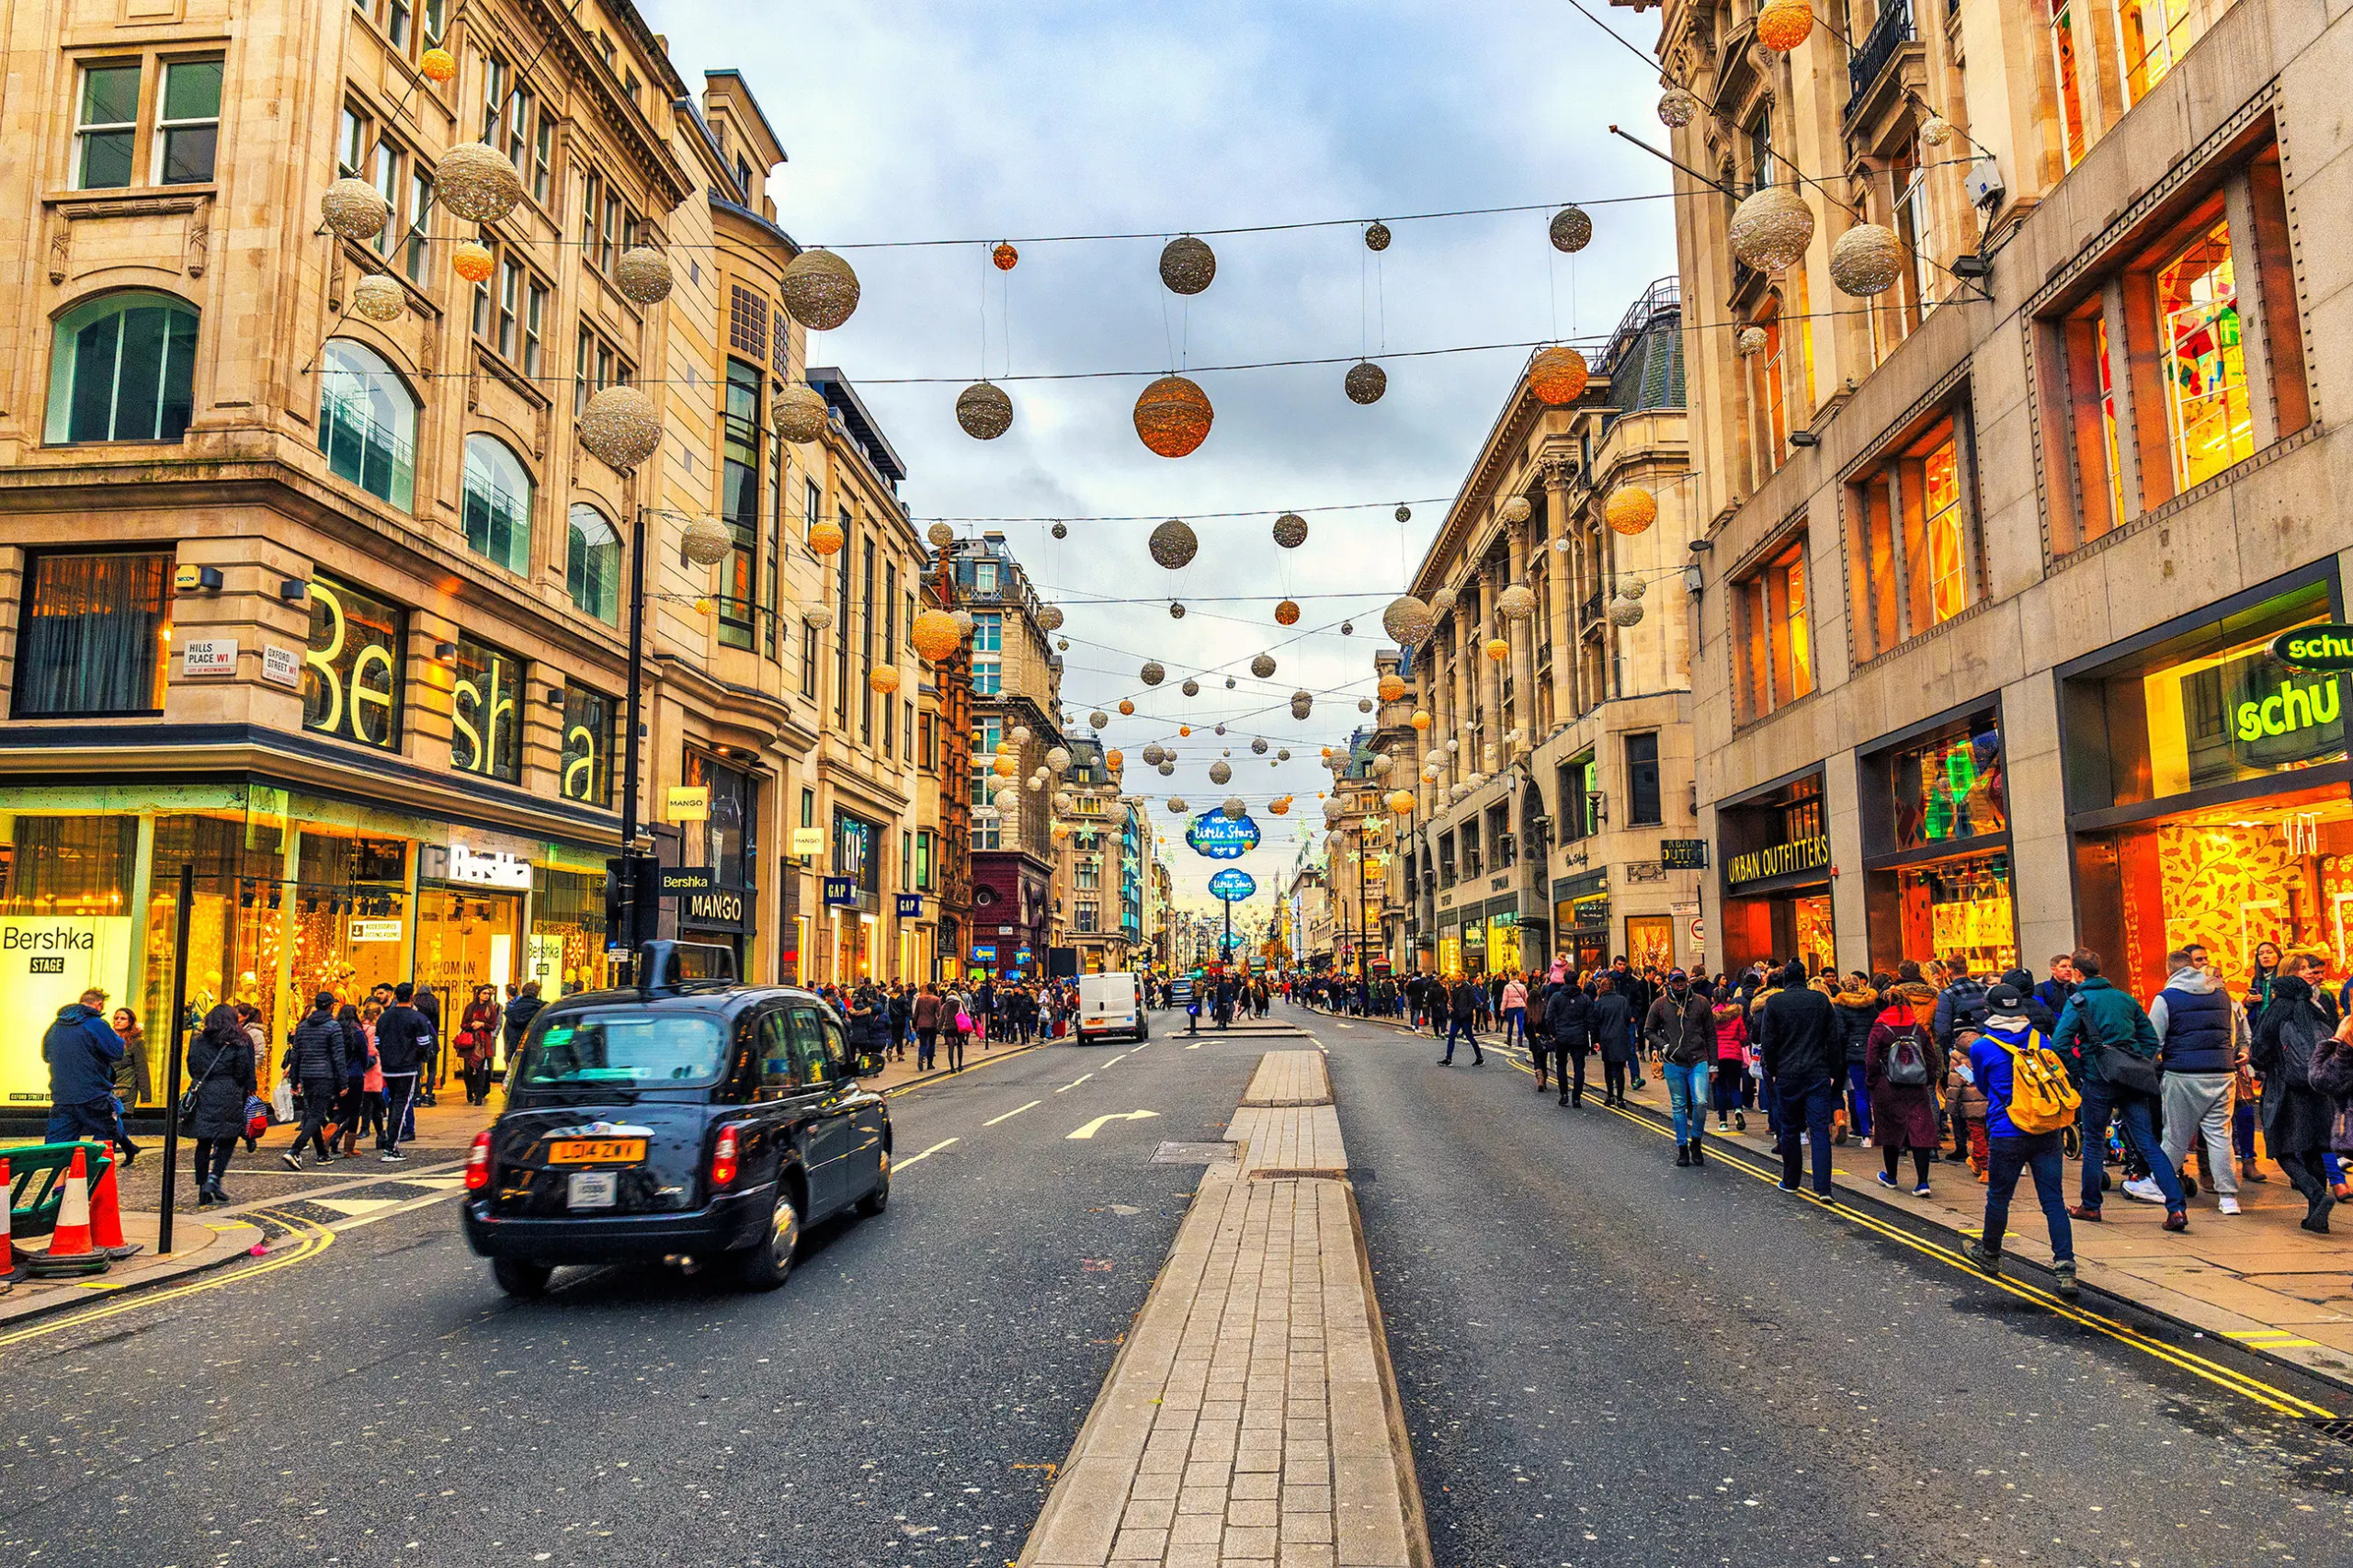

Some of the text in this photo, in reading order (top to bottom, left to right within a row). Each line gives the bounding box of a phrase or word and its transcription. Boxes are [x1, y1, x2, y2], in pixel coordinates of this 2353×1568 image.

[189, 643, 212, 653] HILLS
[188, 653, 229, 664] PLACE W1
[267, 648, 290, 664] OXFORD
[267, 659, 297, 675] STREET W1
[1226, 824, 1255, 838] Stars
[1728, 835, 1828, 882] URBAN OUTFITTERS
[663, 876, 708, 888] Bershka
[828, 884, 846, 898] GAP
[691, 895, 742, 921] MANGO
[900, 900, 915, 911] GAP
[4, 926, 94, 949] Bershka
[528, 943, 559, 959] Bershka
[32, 959, 63, 971] STAGE
